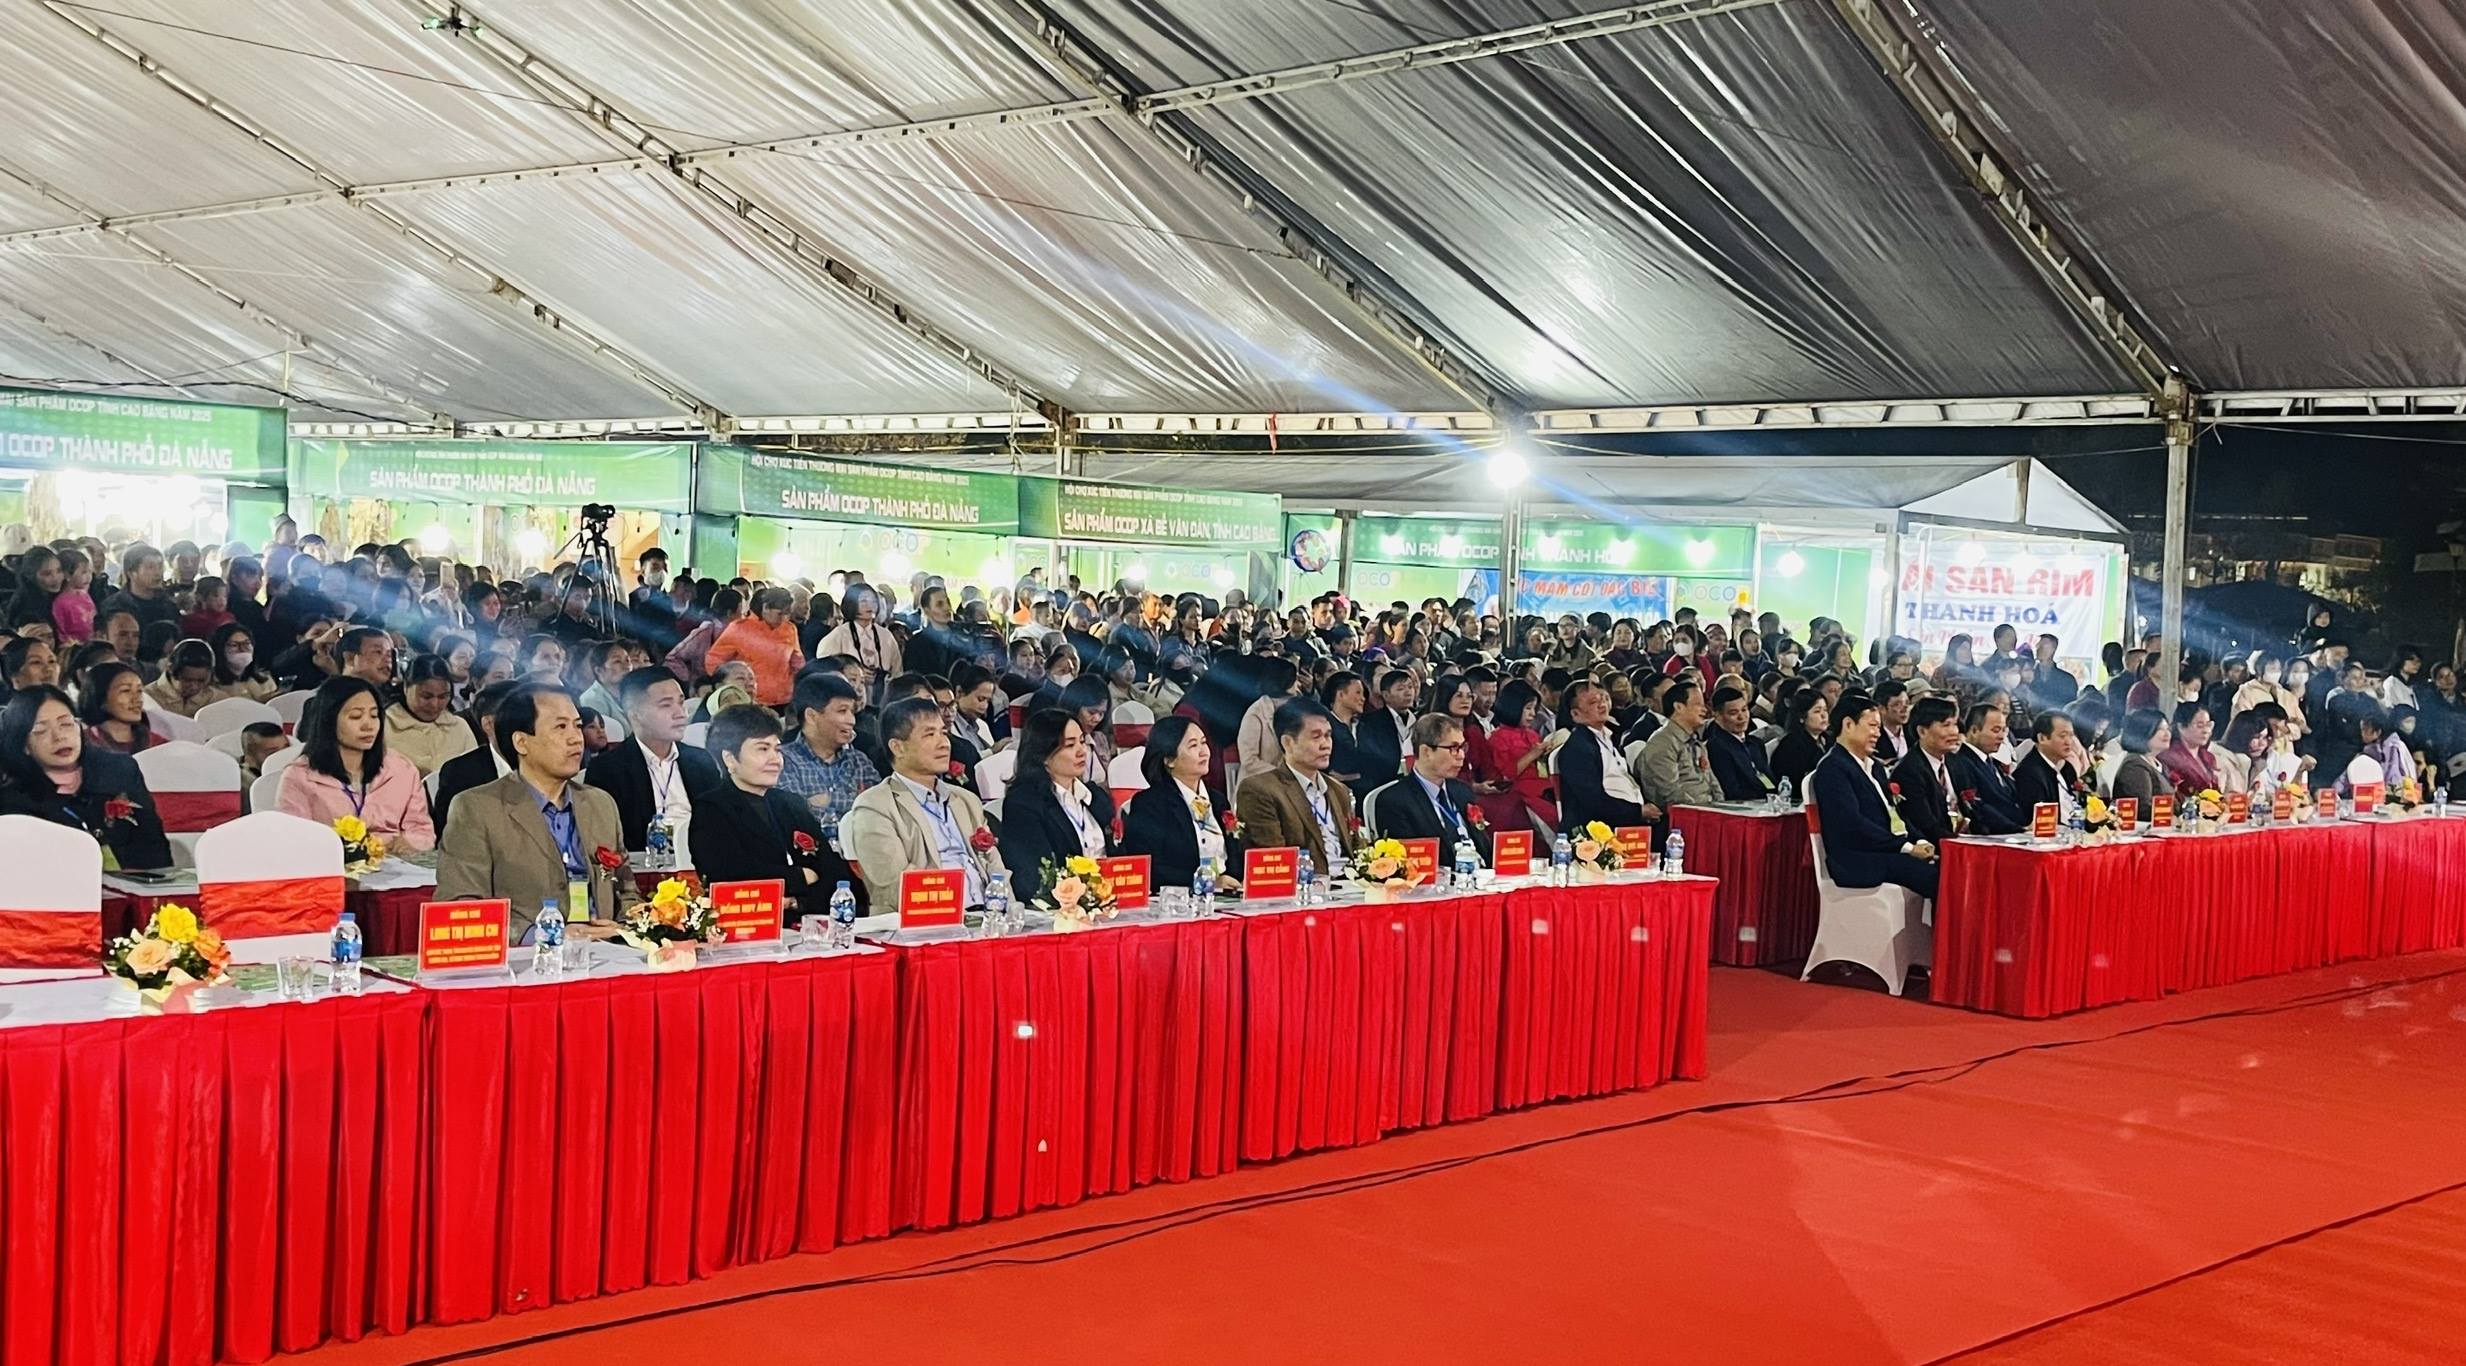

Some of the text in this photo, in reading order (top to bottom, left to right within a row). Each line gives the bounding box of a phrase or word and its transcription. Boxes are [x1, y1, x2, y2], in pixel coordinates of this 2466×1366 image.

[8, 433, 55, 458] OCOP
[59, 434, 118, 463] THÀNH
[463, 471, 505, 492] THÀNH
[781, 485, 807, 509] SẢN
[808, 484, 840, 512] PHẨM
[841, 495, 870, 514] OCOP
[872, 494, 909, 518] THÀNH
[910, 495, 931, 520] PHỐ
[1064, 508, 1086, 531] SẢN
[1086, 507, 1114, 532] PHẨM
[1115, 515, 1139, 534] OCOP
[1462, 545, 1499, 559] OCOP
[1905, 602, 2059, 624] THANH HOÁ
